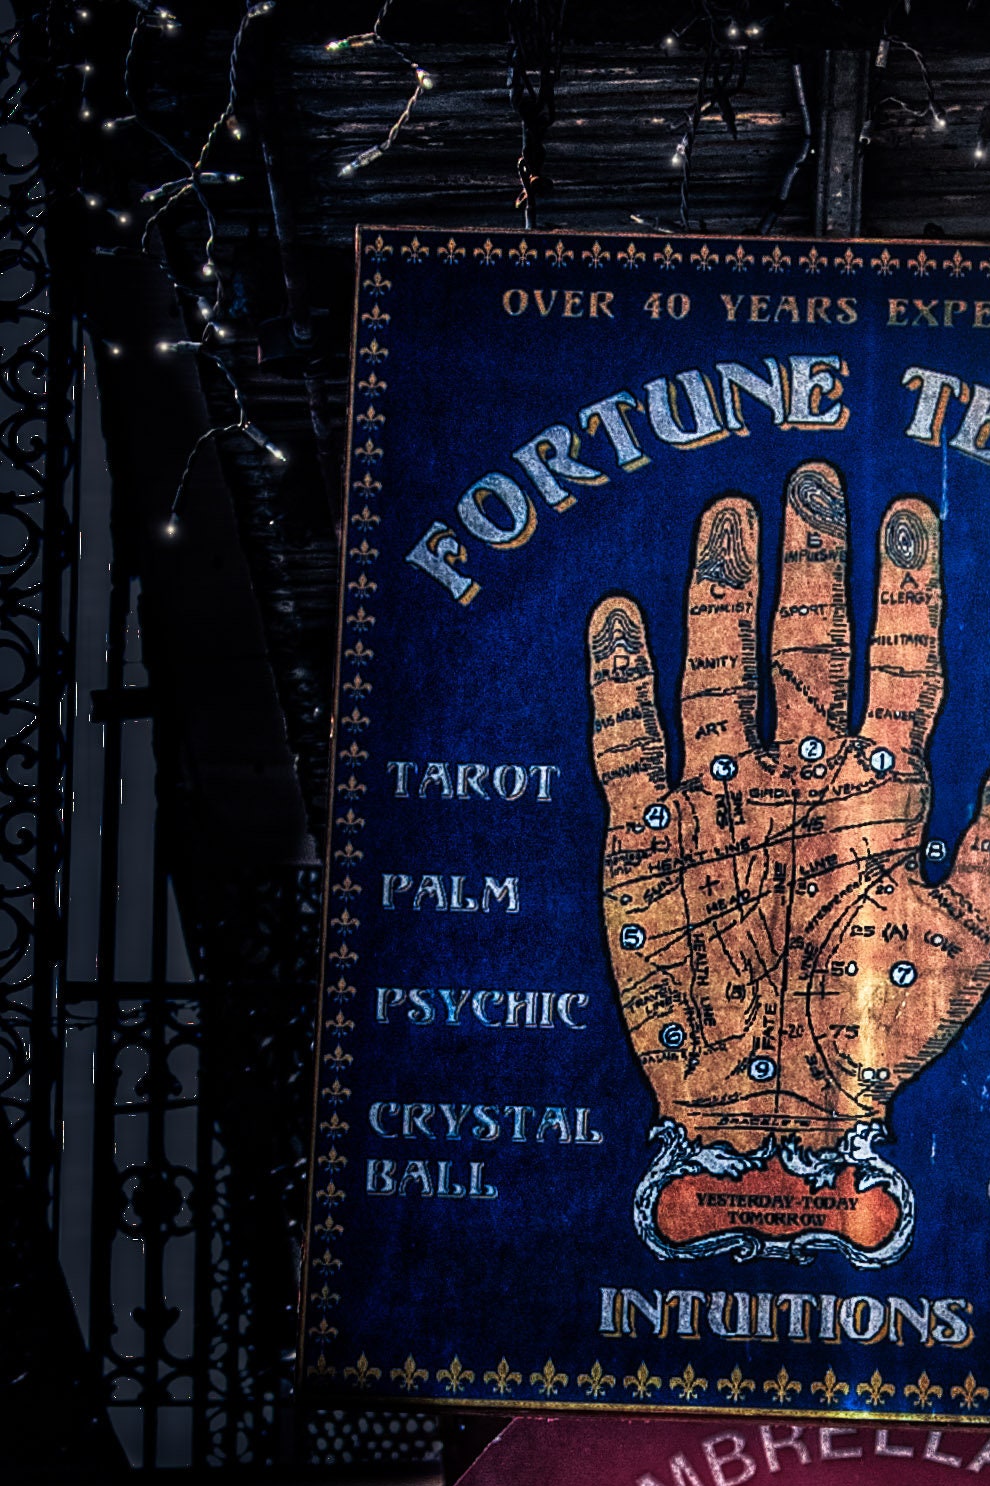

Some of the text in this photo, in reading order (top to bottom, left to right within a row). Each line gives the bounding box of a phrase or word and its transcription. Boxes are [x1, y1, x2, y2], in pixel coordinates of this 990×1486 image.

[502, 288, 614, 319] OVER
[643, 291, 691, 320] 40
[720, 293, 858, 325] YEARS
[405, 354, 850, 606] FORTUNE
[779, 603, 824, 618] SPORT
[880, 590, 933, 605] CLERGY
[688, 655, 738, 671] VANITY
[694, 719, 728, 740] ART
[386, 760, 561, 802] TAROT
[381, 873, 520, 914] PALM
[830, 960, 859, 977] 50
[375, 986, 590, 1029] PSYCHIC
[762, 1002, 778, 1051] FATE
[368, 1101, 604, 1145] CRYSTAL
[366, 1158, 499, 1199] BALL
[727, 1210, 827, 1226] TOMORROW
[599, 1286, 975, 1348] INTUITIONS
